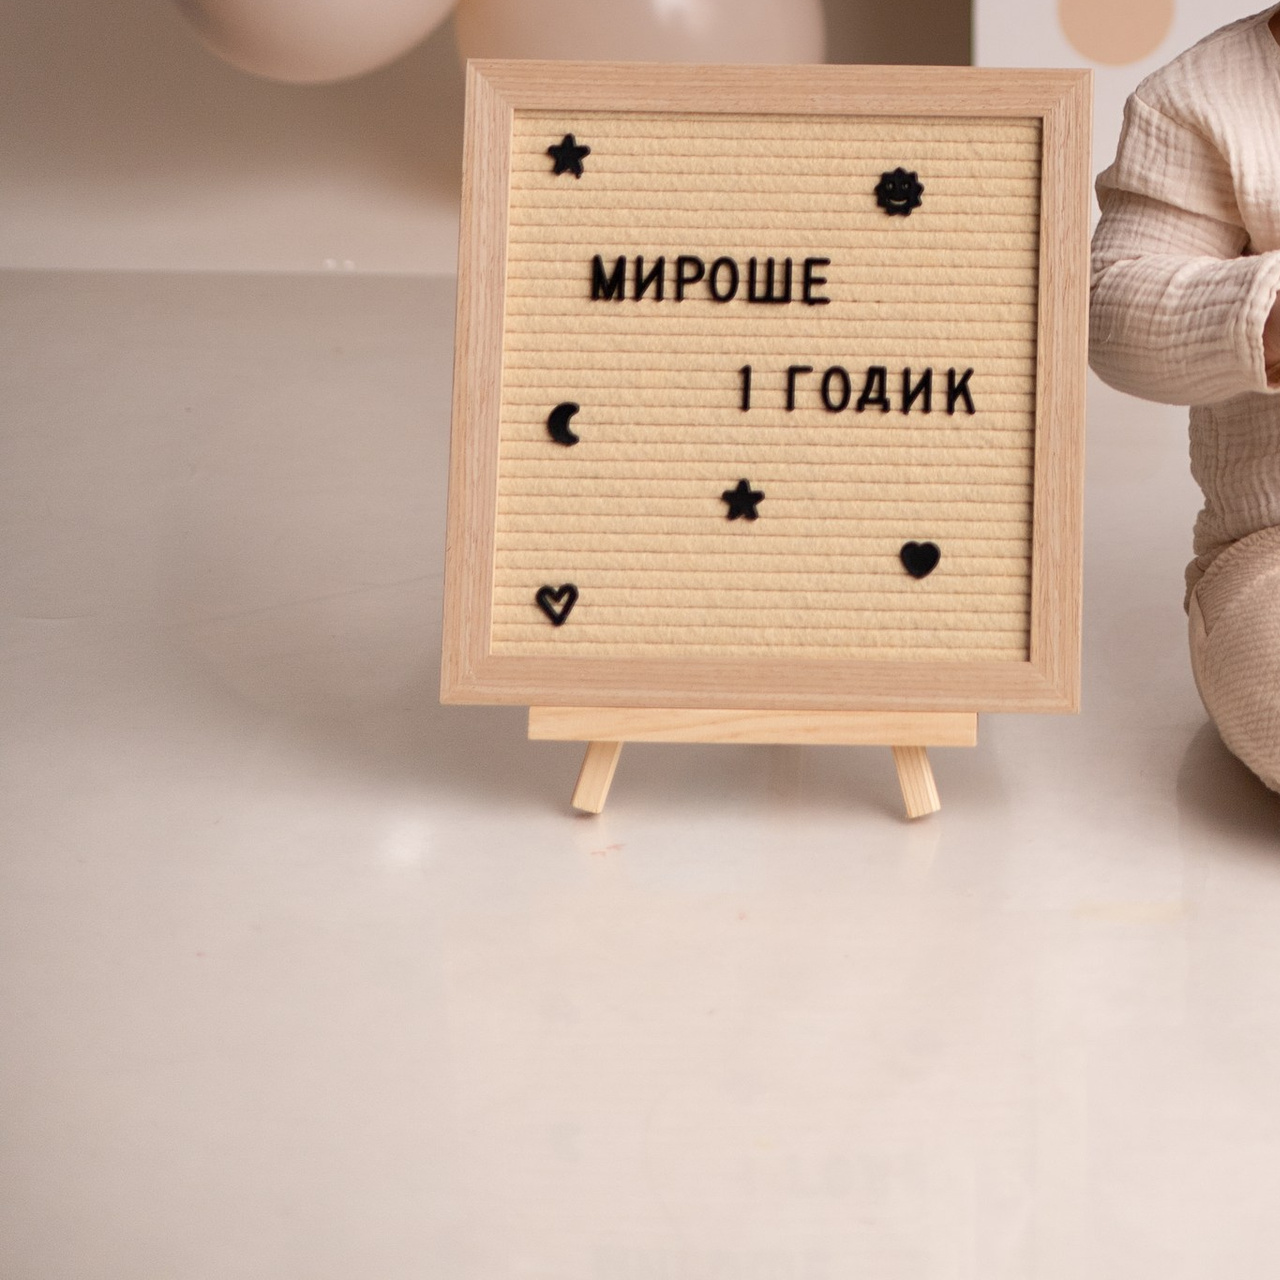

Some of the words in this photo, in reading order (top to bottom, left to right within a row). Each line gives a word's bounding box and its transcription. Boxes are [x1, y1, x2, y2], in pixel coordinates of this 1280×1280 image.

[588, 254, 832, 306] МИРОШЕ
[738, 364, 753, 413] 1
[784, 365, 977, 416] ГОДИК
